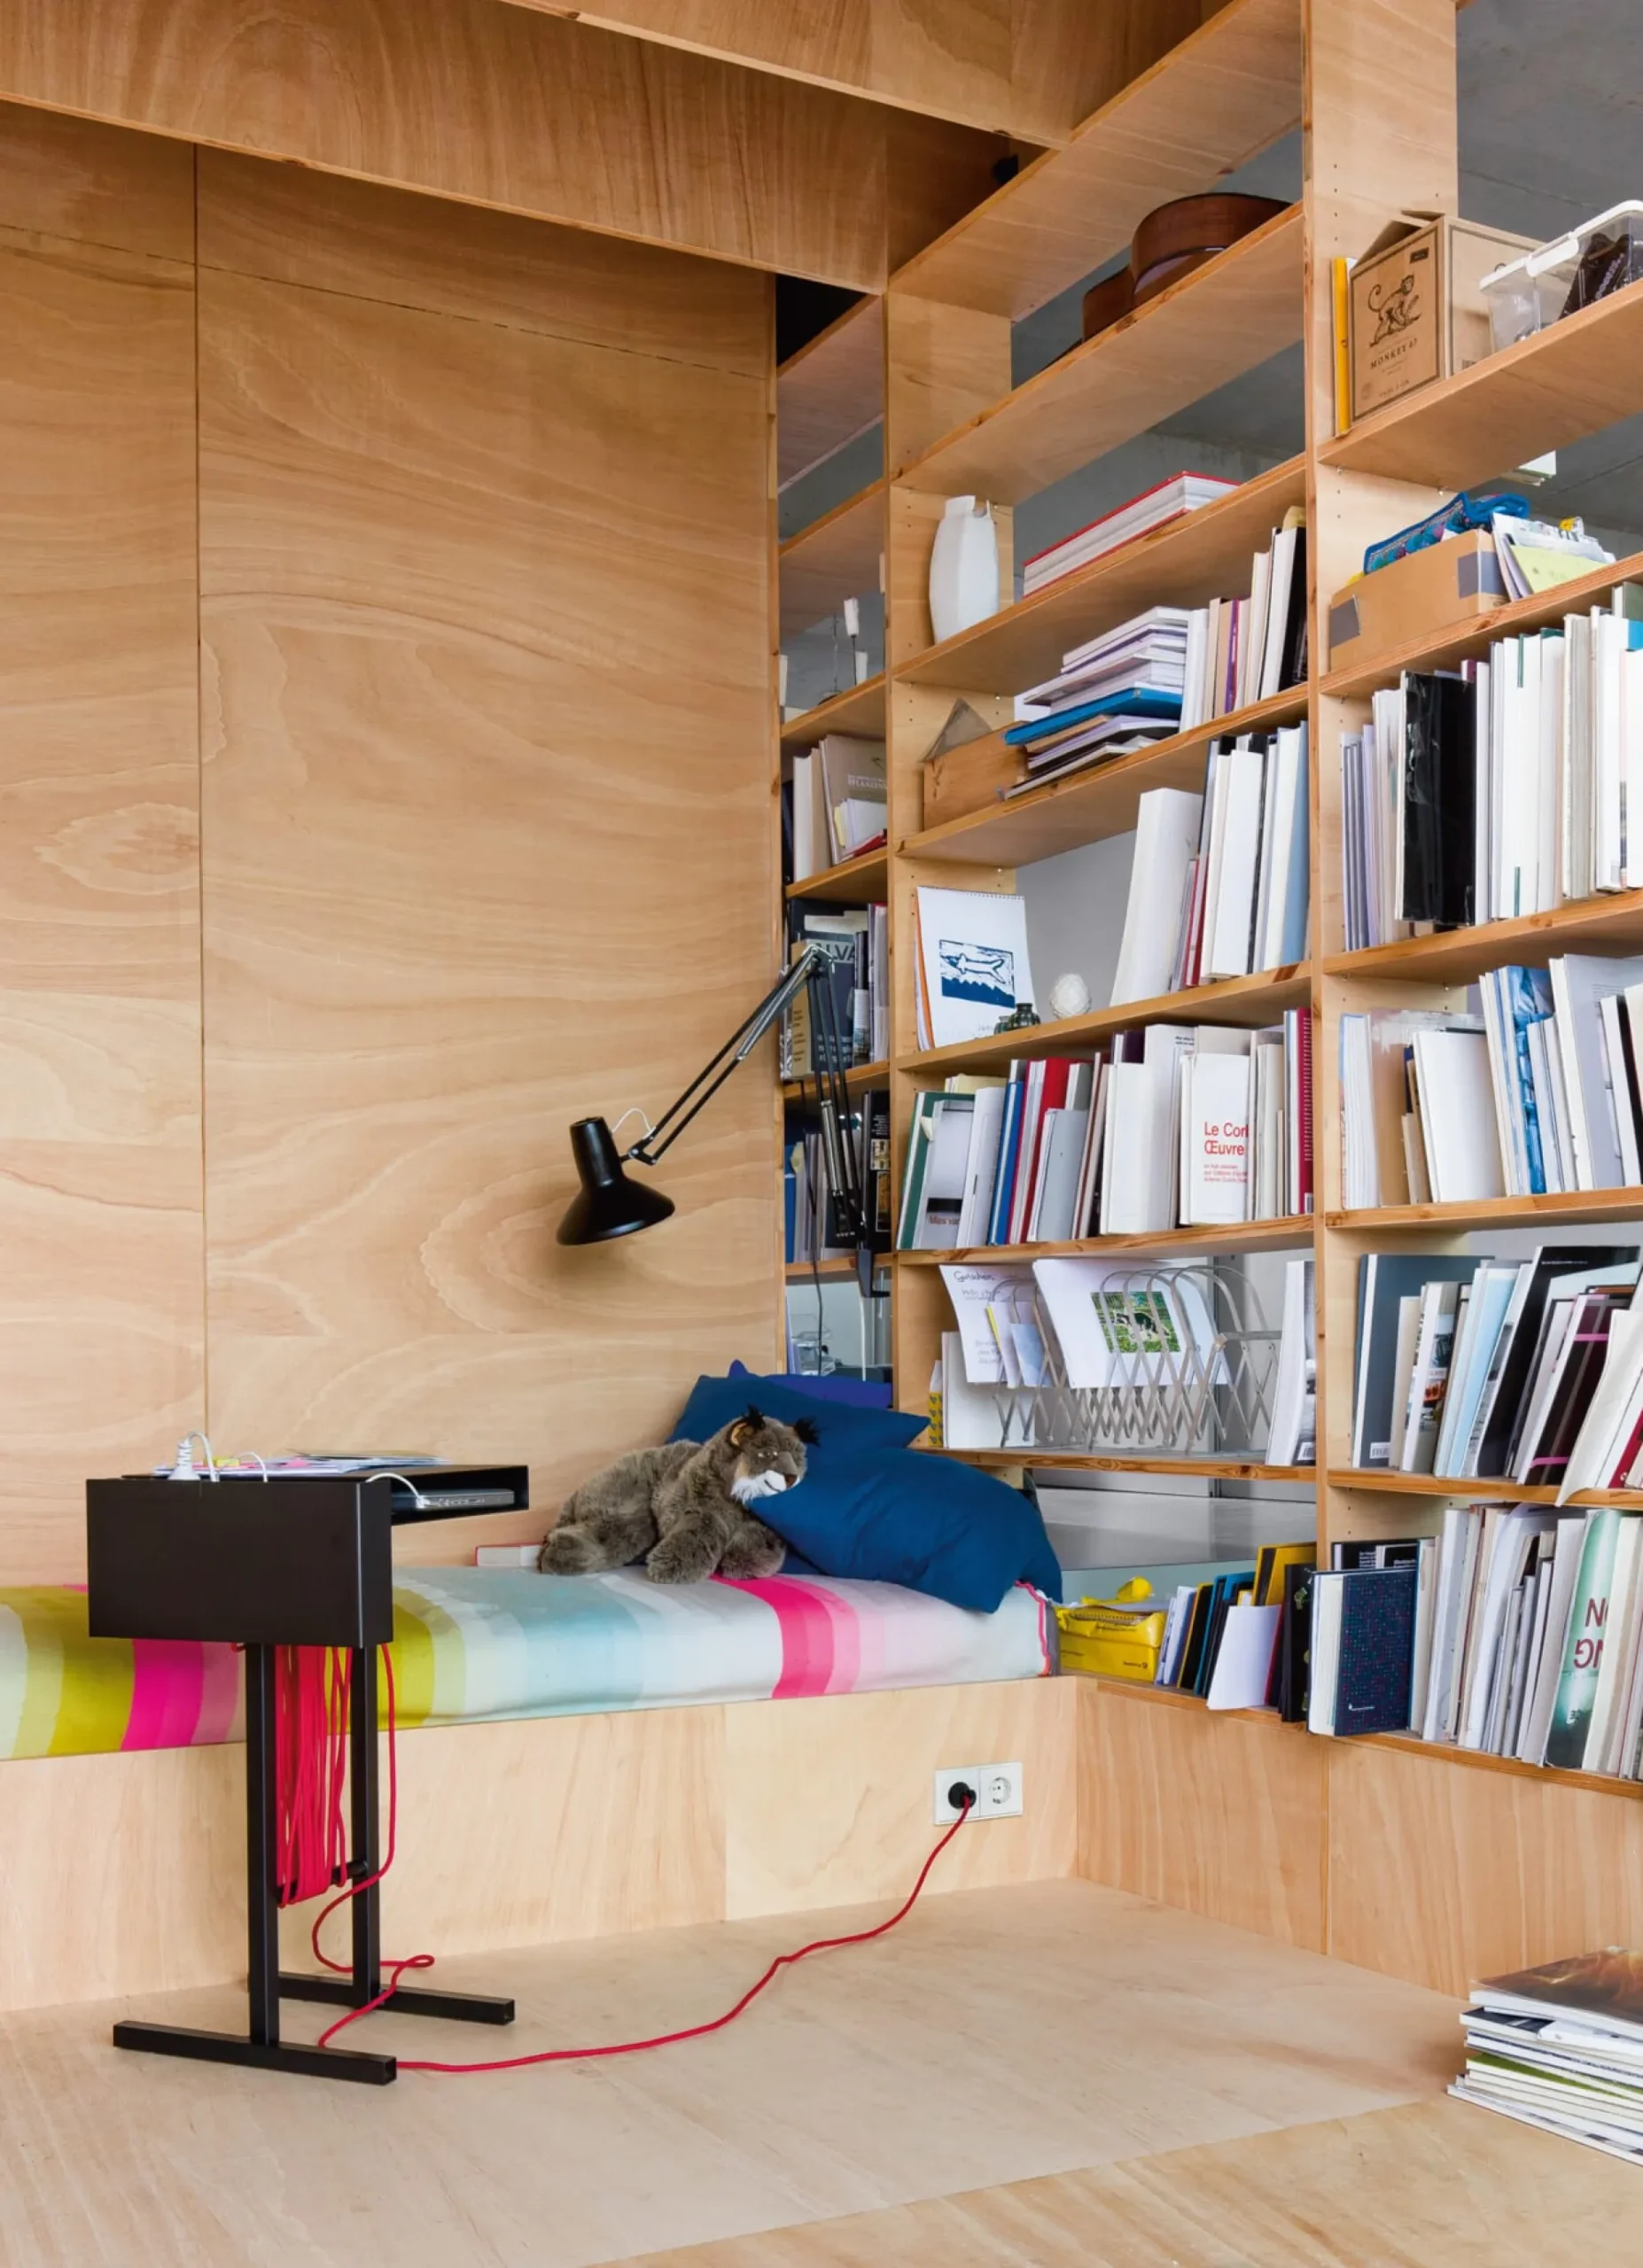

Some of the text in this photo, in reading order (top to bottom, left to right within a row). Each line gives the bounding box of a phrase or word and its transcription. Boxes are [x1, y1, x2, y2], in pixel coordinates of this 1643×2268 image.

[1370, 345, 1406, 369] MONKEY
[1204, 1122, 1219, 1136] Le
[1204, 1139, 1244, 1156] Œuvre
